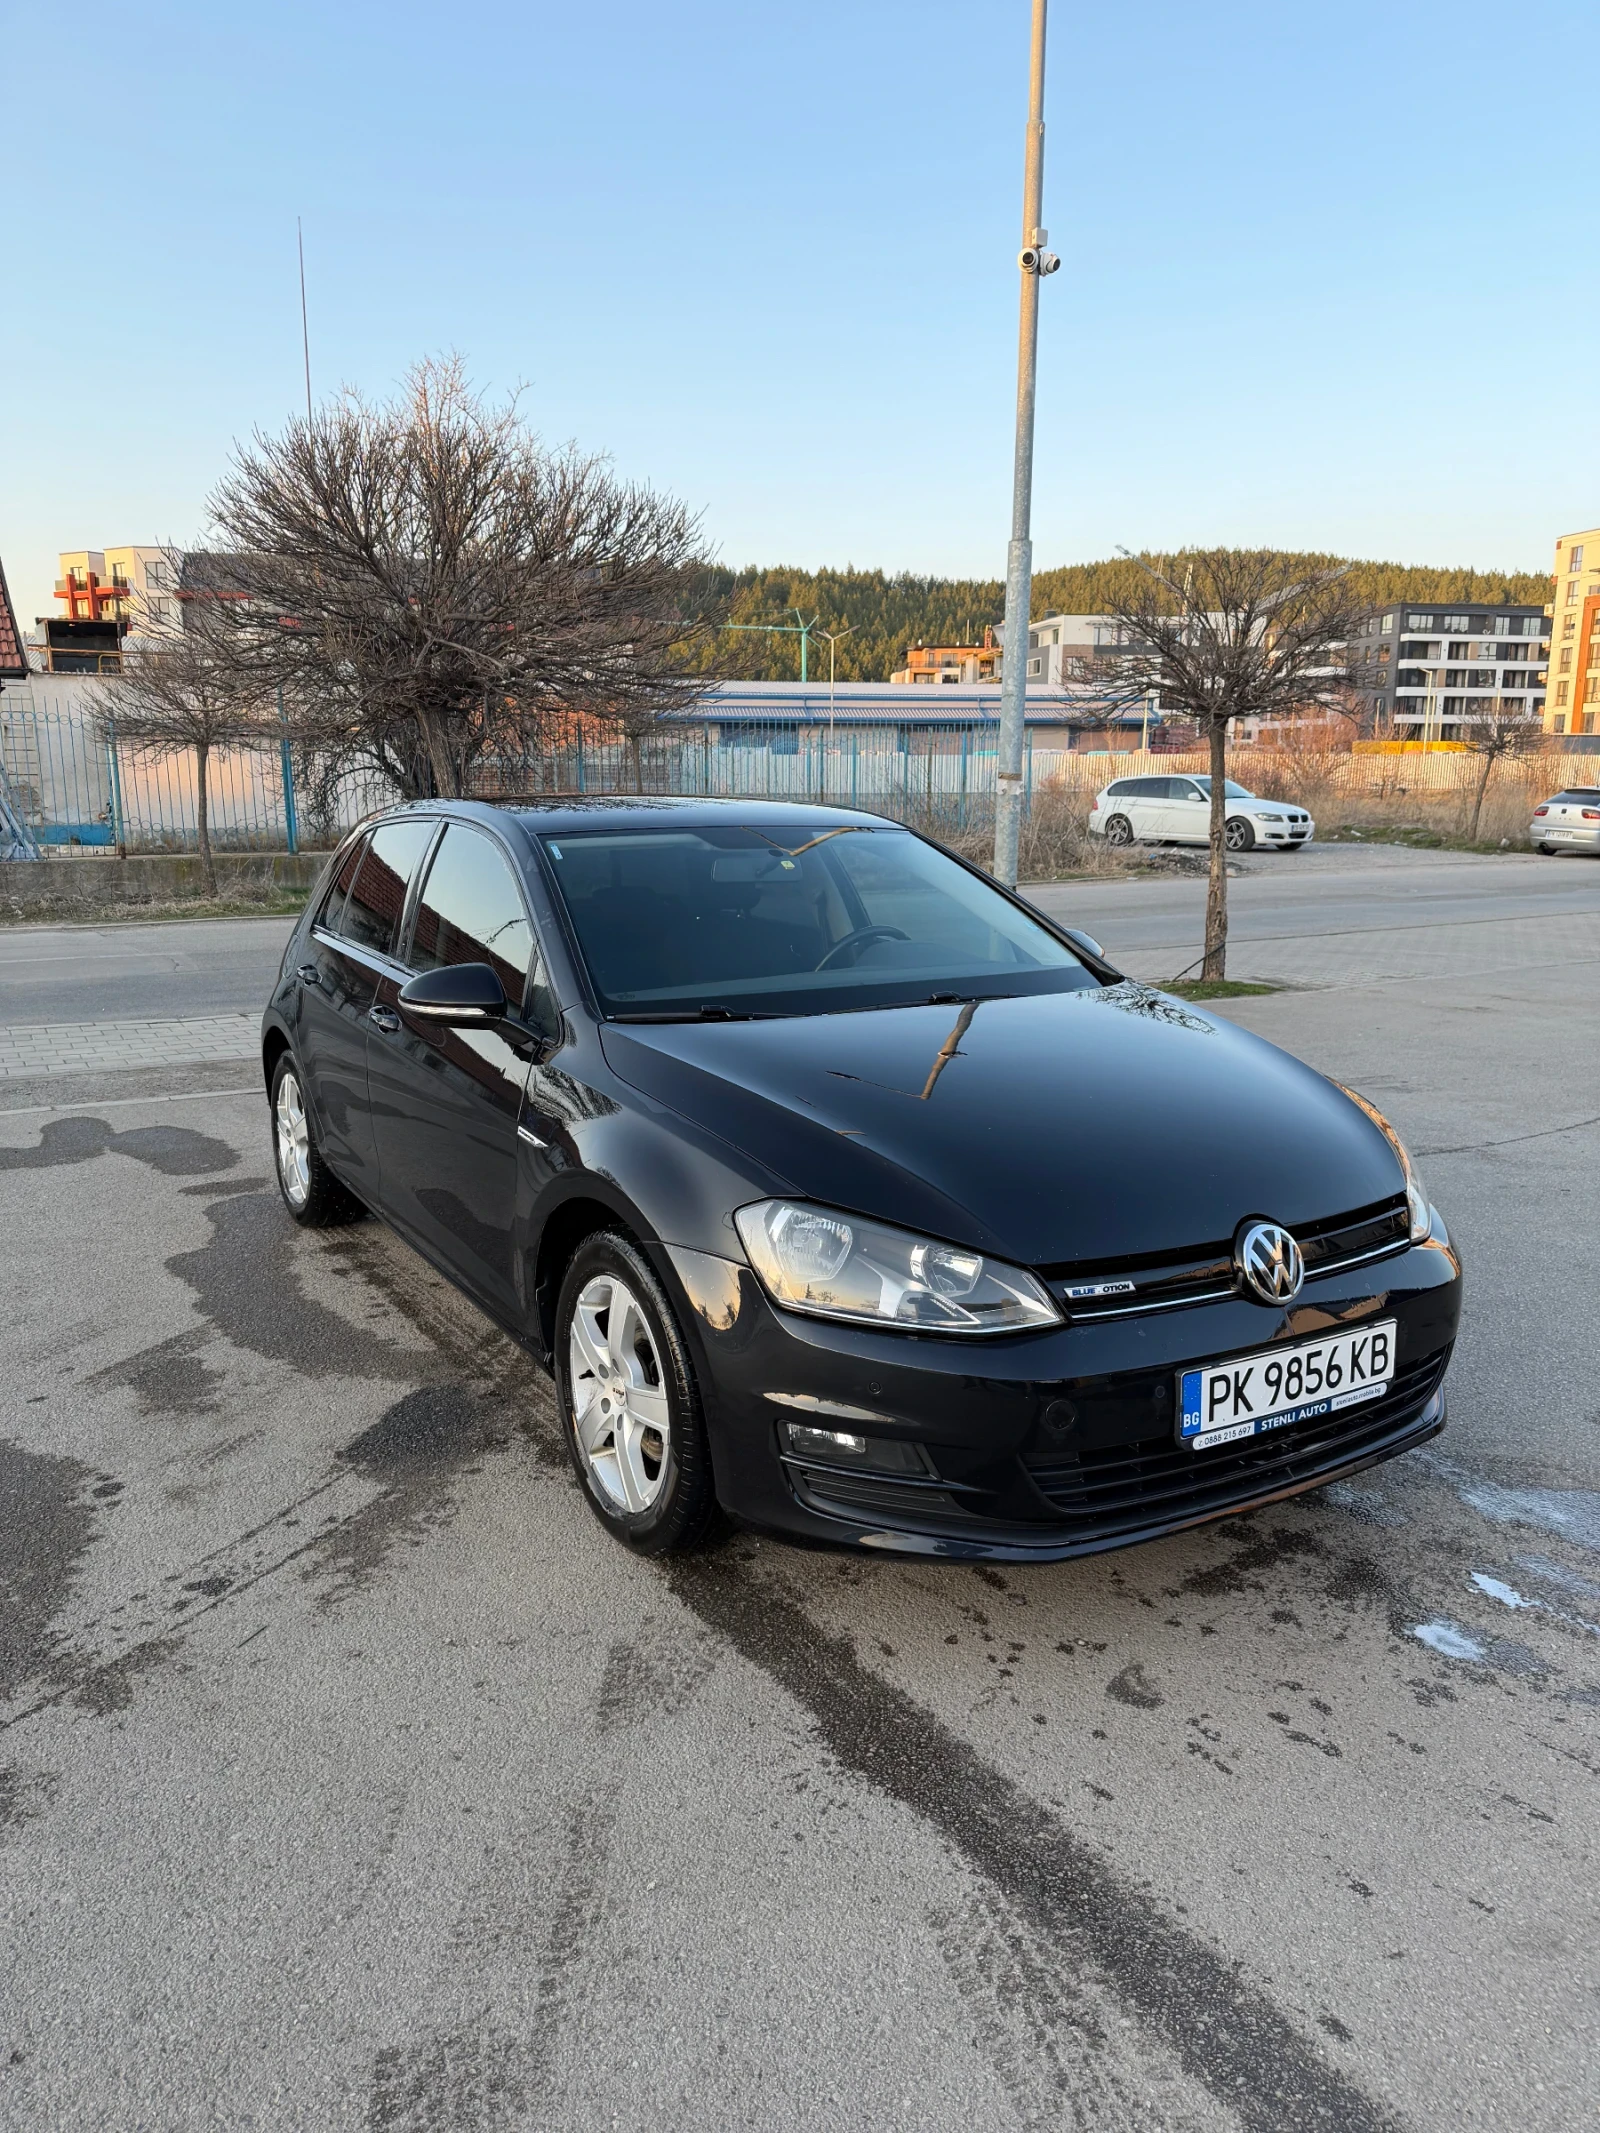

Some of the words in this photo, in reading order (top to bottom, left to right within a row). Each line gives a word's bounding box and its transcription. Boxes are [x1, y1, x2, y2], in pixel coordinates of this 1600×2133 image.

[1209, 1367, 1254, 1422] PK
[1264, 1345, 1343, 1406] 9856
[1350, 1333, 1388, 1383] KB
[1183, 1412, 1200, 1427] BG
[1261, 1411, 1296, 1430] STENLI
[1299, 1402, 1328, 1419] AUTO
[1204, 1433, 1222, 1445] 0888
[1223, 1429, 1237, 1440] 215
[1238, 1425, 1252, 1435] 697
